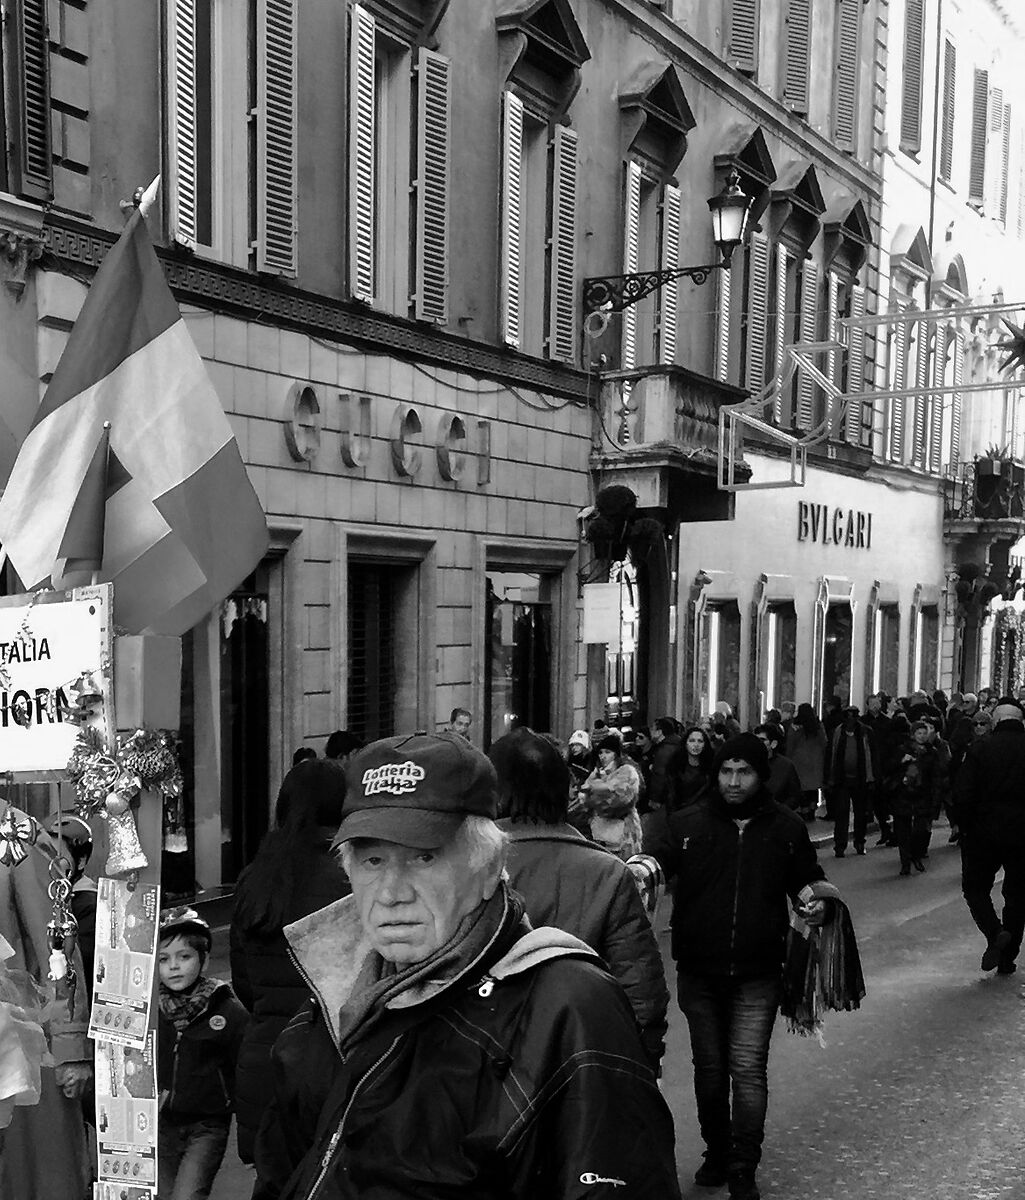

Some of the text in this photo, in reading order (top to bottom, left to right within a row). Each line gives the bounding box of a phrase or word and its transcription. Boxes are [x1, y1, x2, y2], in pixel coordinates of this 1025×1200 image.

[284, 380, 492, 486] GUCCI
[797, 500, 873, 549] BVLGARI
[365, 763, 423, 782] Lotteria
[367, 777, 416, 792] Italia
